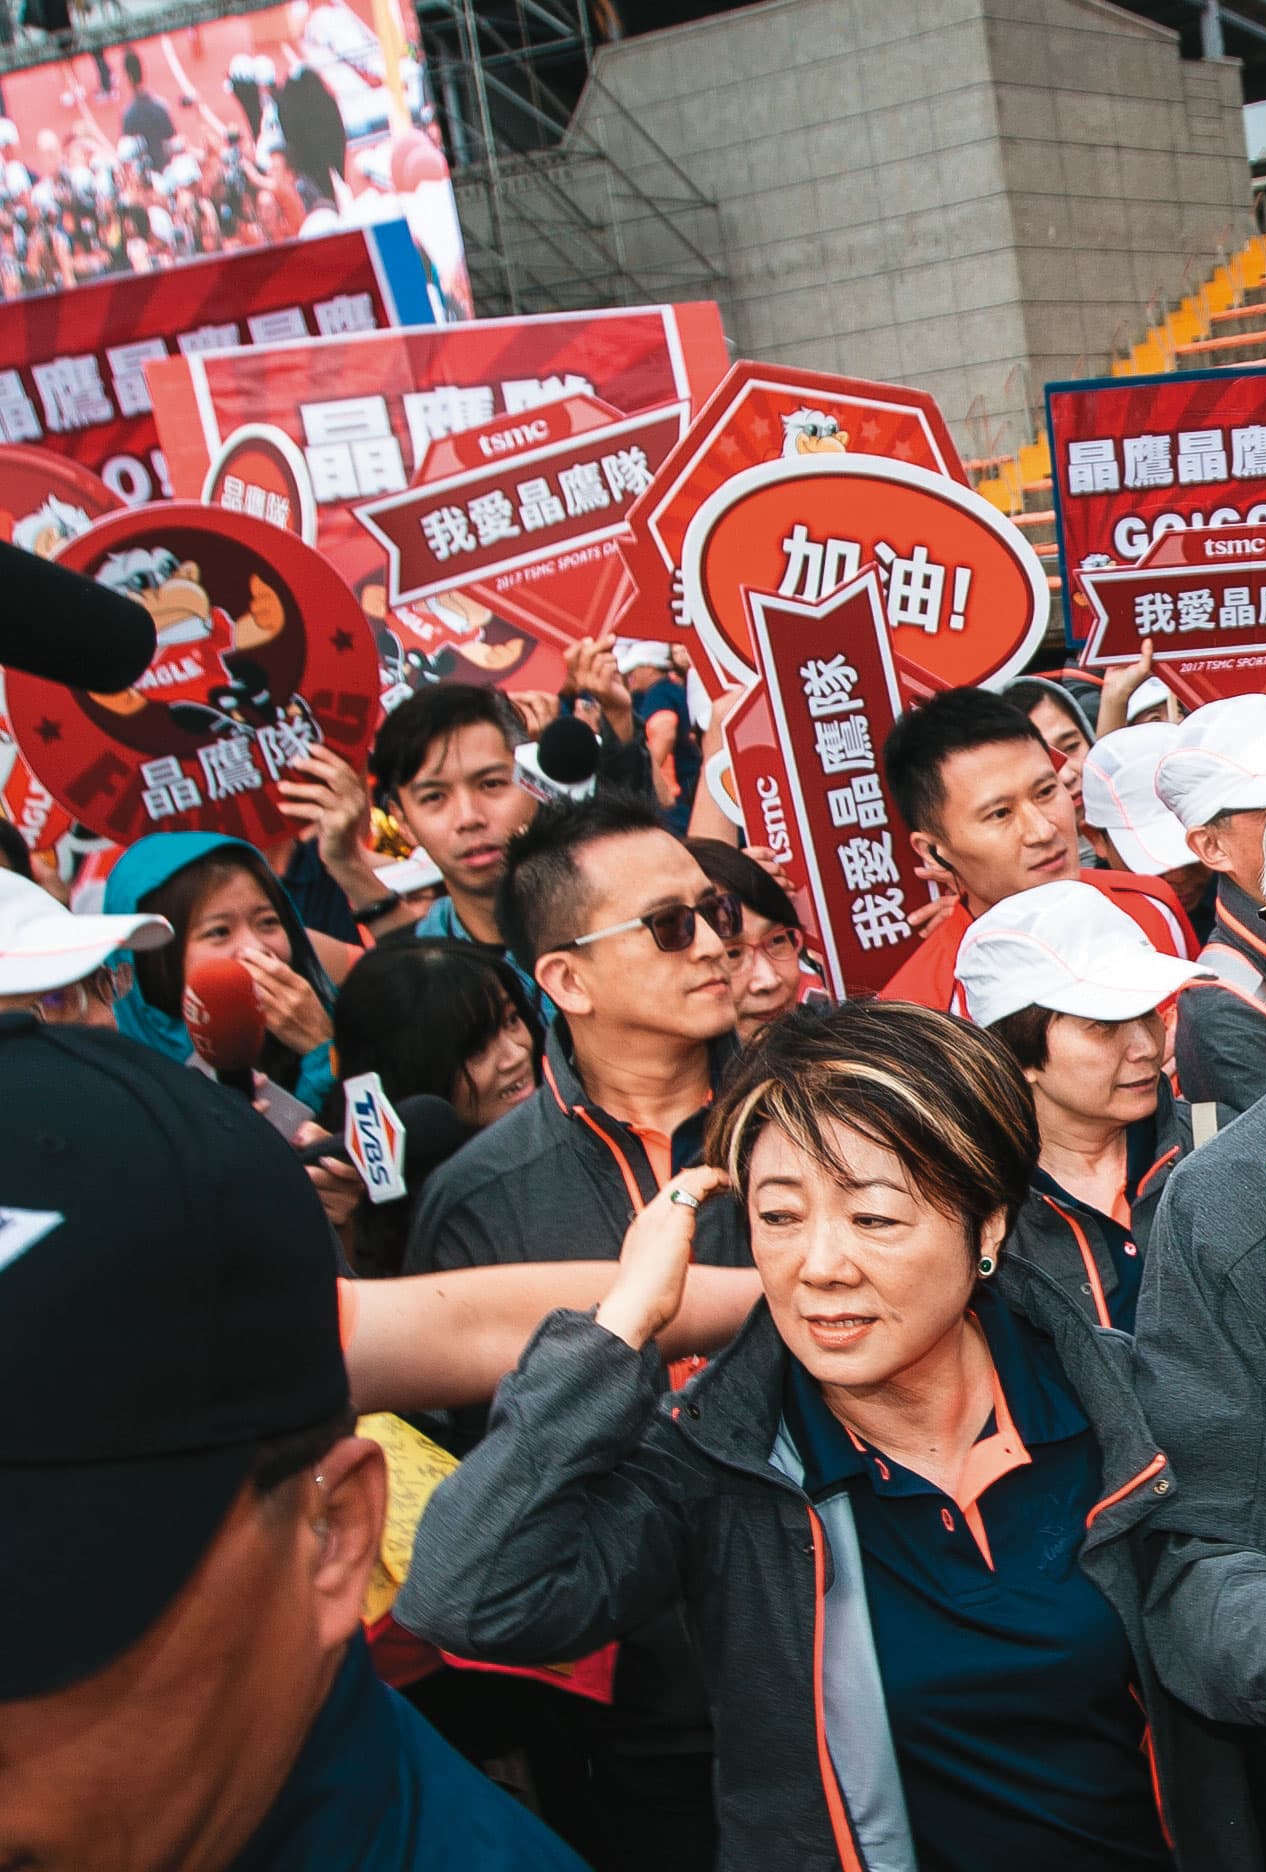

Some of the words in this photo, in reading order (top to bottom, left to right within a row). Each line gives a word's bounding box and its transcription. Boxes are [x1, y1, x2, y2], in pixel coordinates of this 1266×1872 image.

[478, 418, 550, 457] tsmc
[420, 446, 656, 562] 我愛晶鷹隊
[1203, 535, 1266, 559] tsmc
[778, 524, 972, 634] 加油!
[1179, 661, 1205, 673] 2017
[1206, 659, 1235, 670] TSMC
[140, 714, 313, 821] 晶鷹隊
[799, 653, 912, 950] 我愛晶鷹隊
[756, 775, 793, 865] tsmc
[355, 1089, 391, 1186] TVBS
